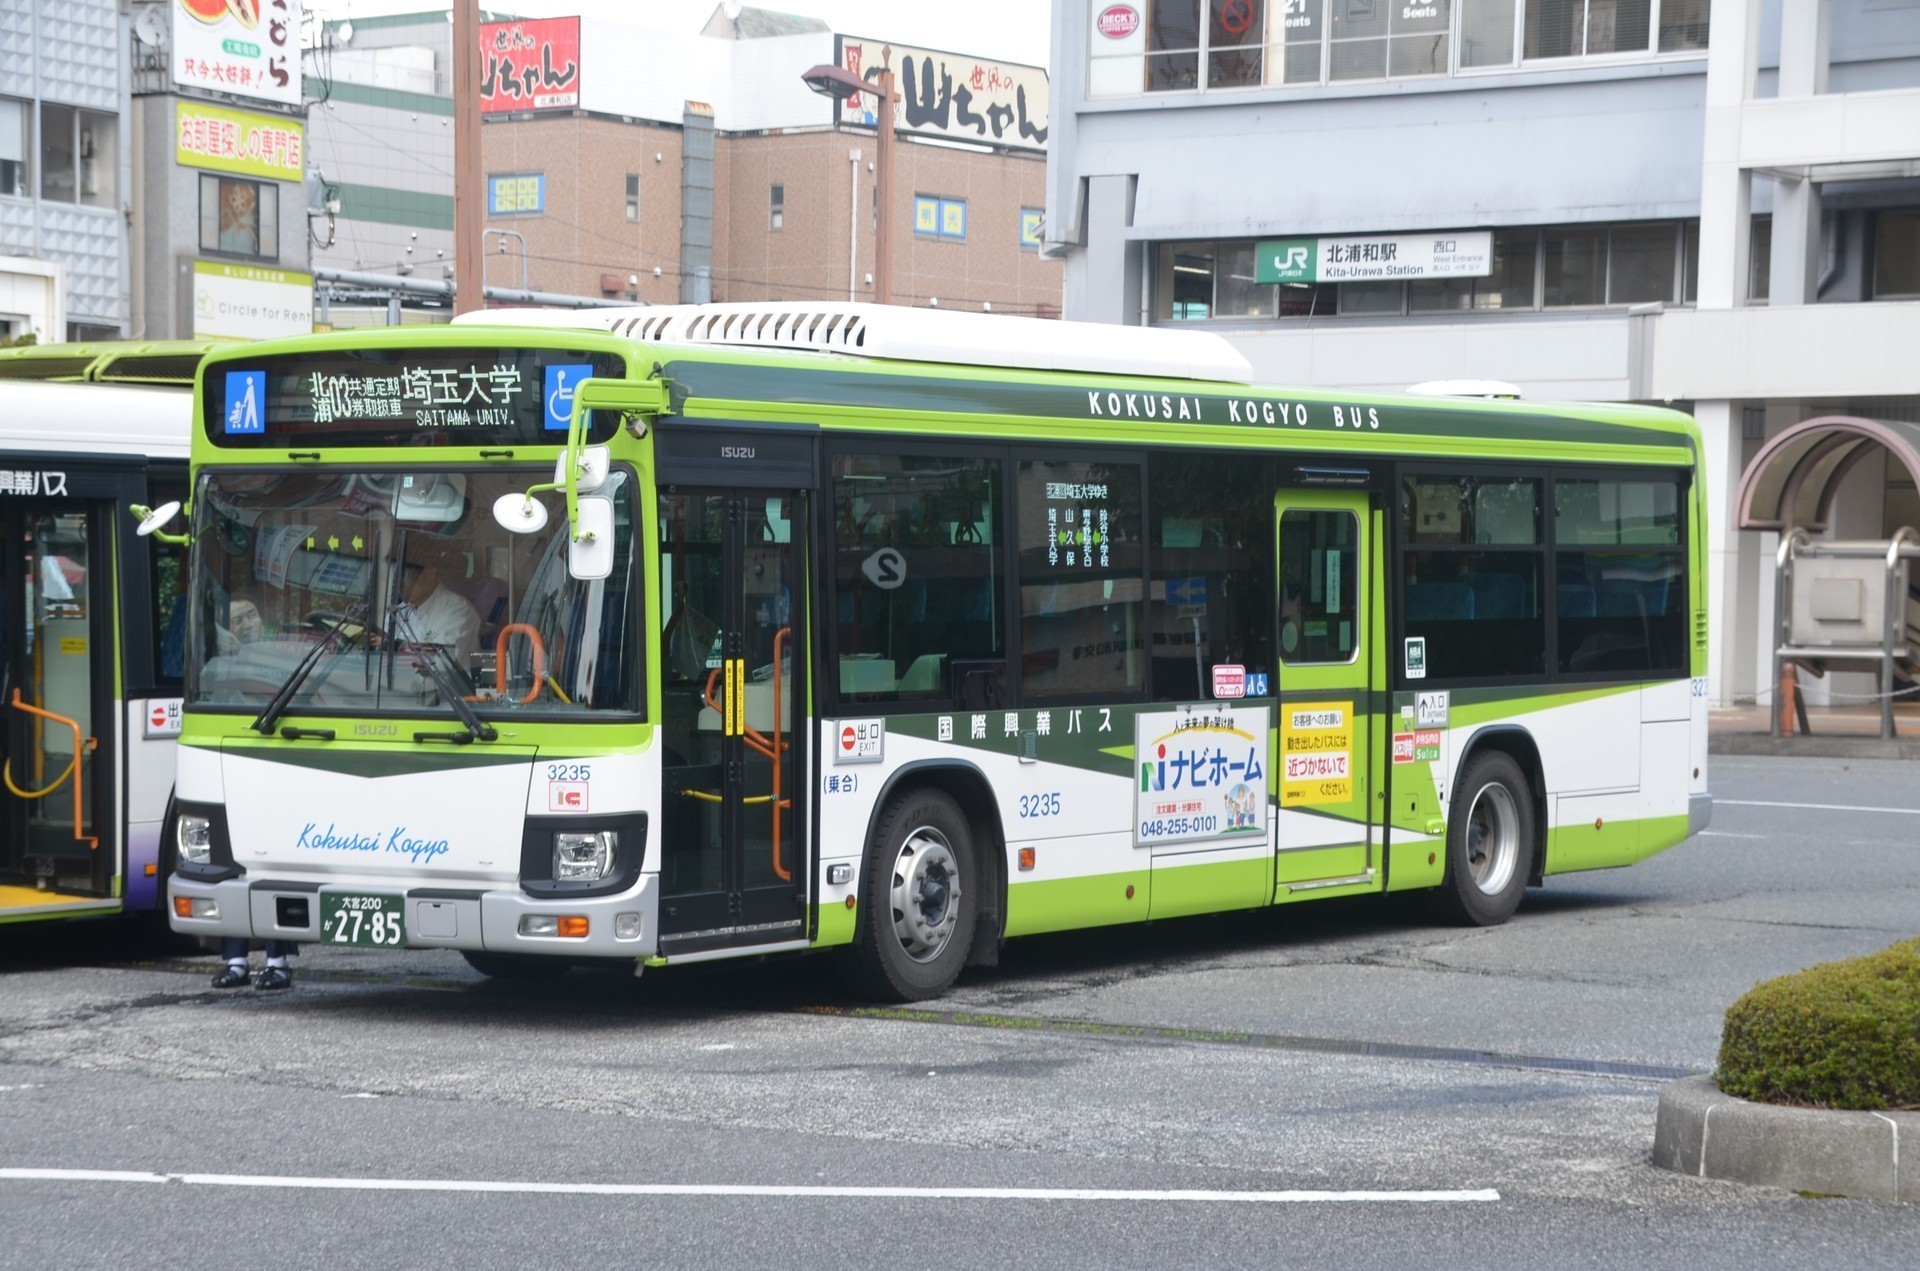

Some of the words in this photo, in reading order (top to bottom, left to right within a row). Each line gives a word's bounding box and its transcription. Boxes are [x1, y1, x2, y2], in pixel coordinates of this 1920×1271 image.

[1402, 7, 1437, 19] Seats
[495, 27, 535, 50] 世界の
[970, 64, 1014, 92] 世界の
[902, 54, 1048, 144] 山ちゃん
[180, 112, 301, 169] お部屋探しの専門店
[1326, 243, 1397, 263] 北浦和駅
[1433, 240, 1456, 253] 西口
[1274, 246, 1308, 270] JR
[1325, 266, 1383, 278] Kita-Urawa
[1386, 265, 1424, 276] Station
[219, 302, 258, 318] Circle
[262, 308, 280, 320] for
[284, 309, 311, 323] Rent
[401, 364, 522, 405] 埼玉大学
[415, 409, 471, 426] SAITAMA
[1088, 391, 1201, 420] KOKUSAI
[1228, 400, 1308, 426] KOGYO
[1333, 406, 1379, 429] BUS
[721, 446, 755, 459] ISUZU
[1065, 508, 1075, 566] 山久保
[353, 723, 398, 737] ISUZU
[938, 708, 1112, 741] 国際興業バス
[1293, 713, 1341, 727] お客様へのお願い
[858, 723, 879, 740] 出口
[1416, 733, 1439, 745] PASMO
[860, 741, 875, 752] EXIT
[1287, 735, 1347, 751] 動き出したバスには
[1416, 748, 1438, 760] Suica
[547, 764, 591, 781] 3235
[1170, 747, 1262, 790] ナビホーム
[1288, 756, 1345, 777] 近づかないで
[823, 773, 858, 795] (乗合)
[1019, 792, 1061, 818] 3235
[1141, 815, 1217, 837] 048-255-0101
[296, 823, 382, 852] Kokusai
[385, 827, 449, 864] Kogyo
[342, 896, 382, 910] 大宮200
[334, 909, 401, 945] 27-85
